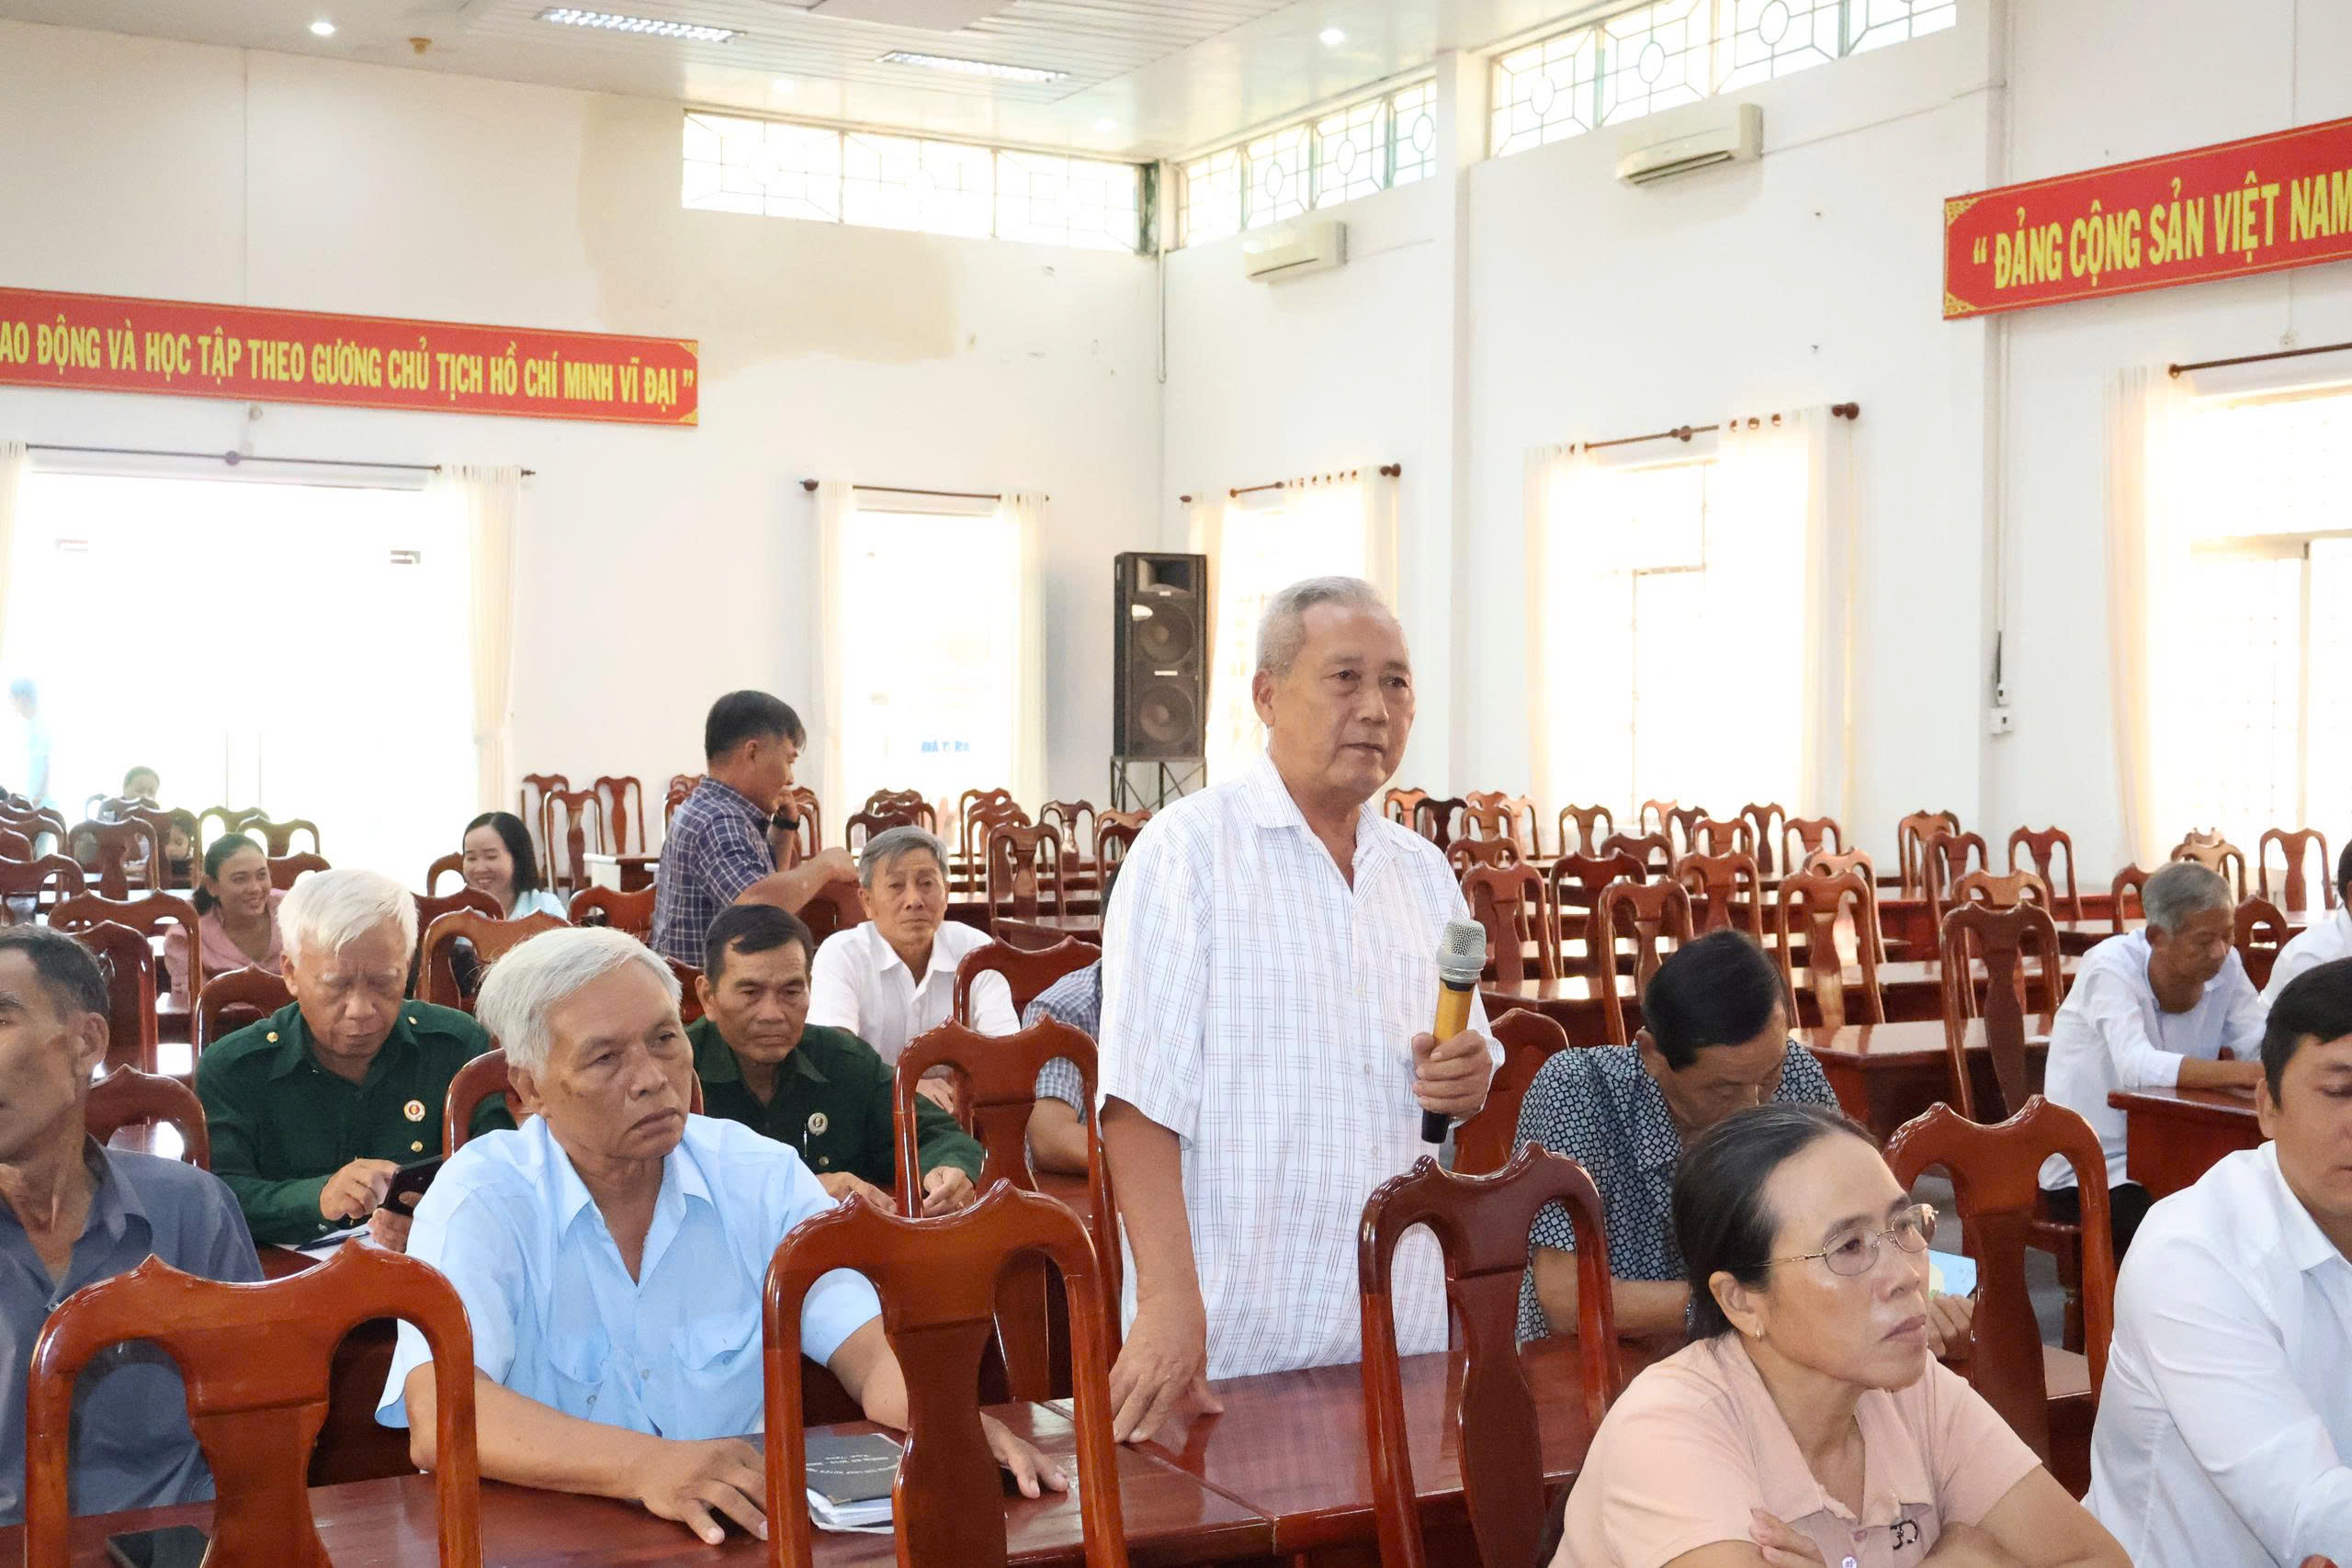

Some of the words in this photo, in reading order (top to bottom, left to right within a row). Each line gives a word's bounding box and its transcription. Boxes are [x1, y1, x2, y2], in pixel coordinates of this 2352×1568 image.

[1995, 207, 2064, 289] ĐẢNG
[2069, 199, 2142, 288] CỘNG
[2149, 176, 2205, 265] SẢN
[2213, 169, 2280, 264] VIỆT
[2290, 167, 2352, 243] NAM
[0, 321, 29, 364] AO
[37, 314, 101, 375] ĐỘNG
[107, 319, 137, 371] VÀ
[145, 332, 192, 382] HỌC
[198, 325, 242, 385] TẬP
[247, 339, 305, 382] THEO
[311, 337, 382, 388] GƯƠNG
[387, 336, 429, 390] CHỦ
[435, 352, 483, 401] TỊCH
[490, 341, 518, 397] HỒ
[524, 351, 559, 398] CHÍ
[563, 360, 614, 401] MINH
[618, 355, 640, 403] VĨ
[643, 367, 678, 412] ĐẠI
